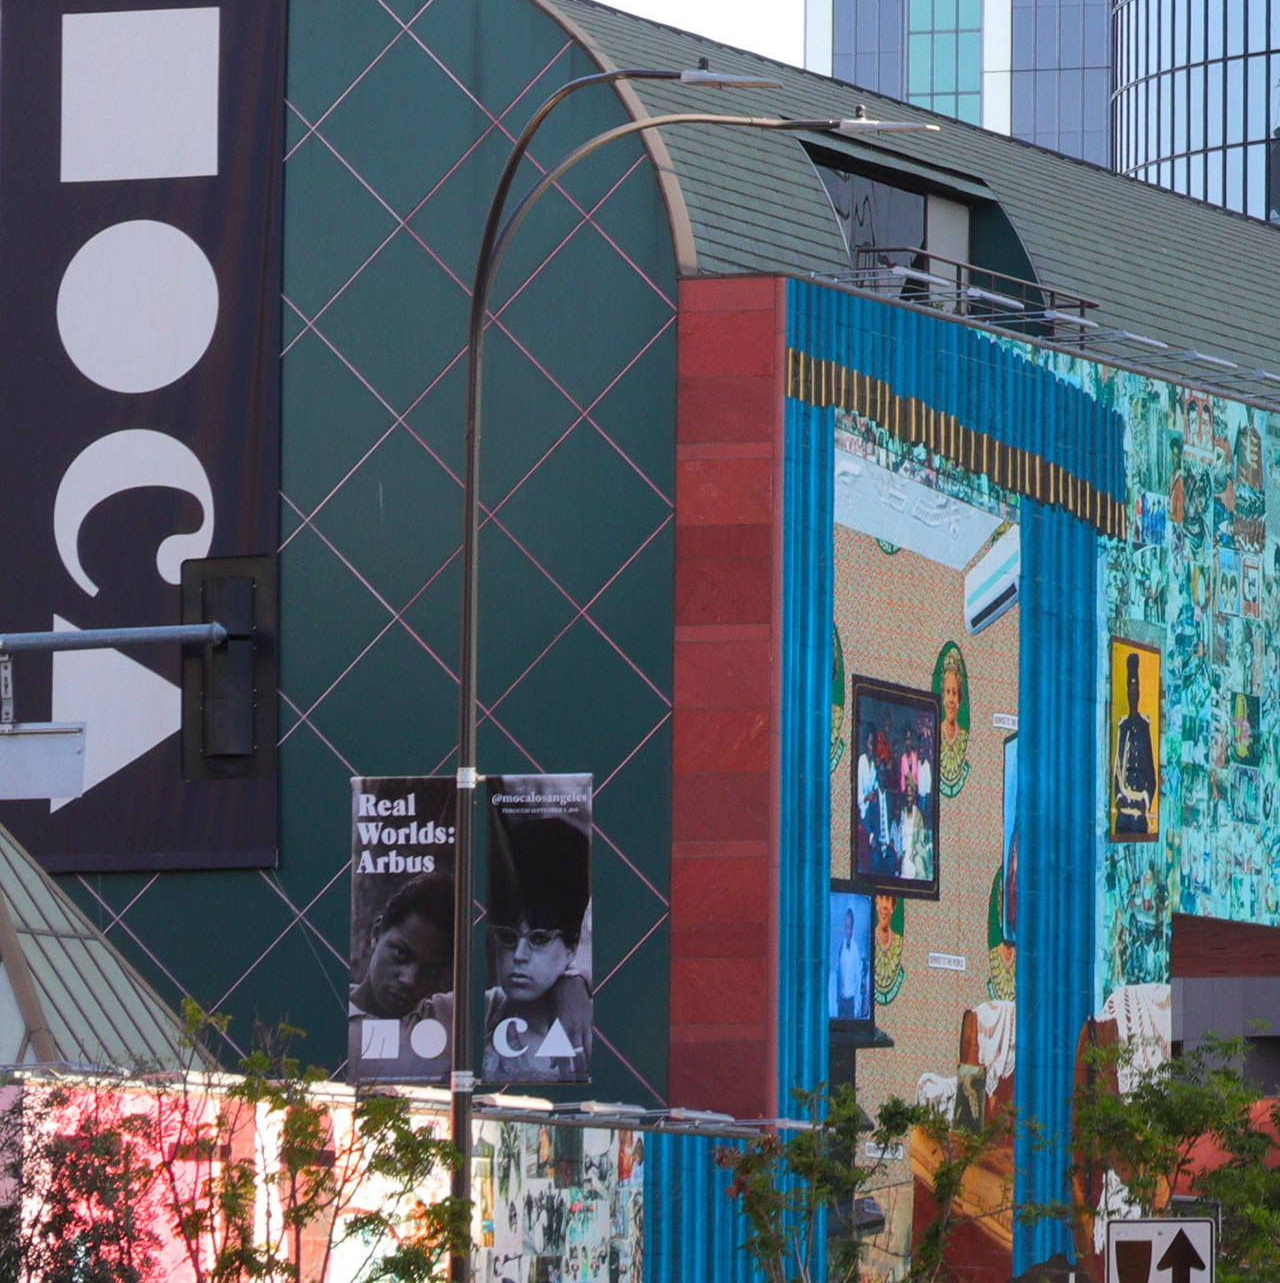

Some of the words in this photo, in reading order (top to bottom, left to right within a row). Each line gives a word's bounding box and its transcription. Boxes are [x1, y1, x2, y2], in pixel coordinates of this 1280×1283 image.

[358, 793, 416, 817] Real
[491, 791, 587, 805] @mocalosangeles
[356, 821, 455, 846] Worlds:
[356, 851, 434, 874] Arbus
